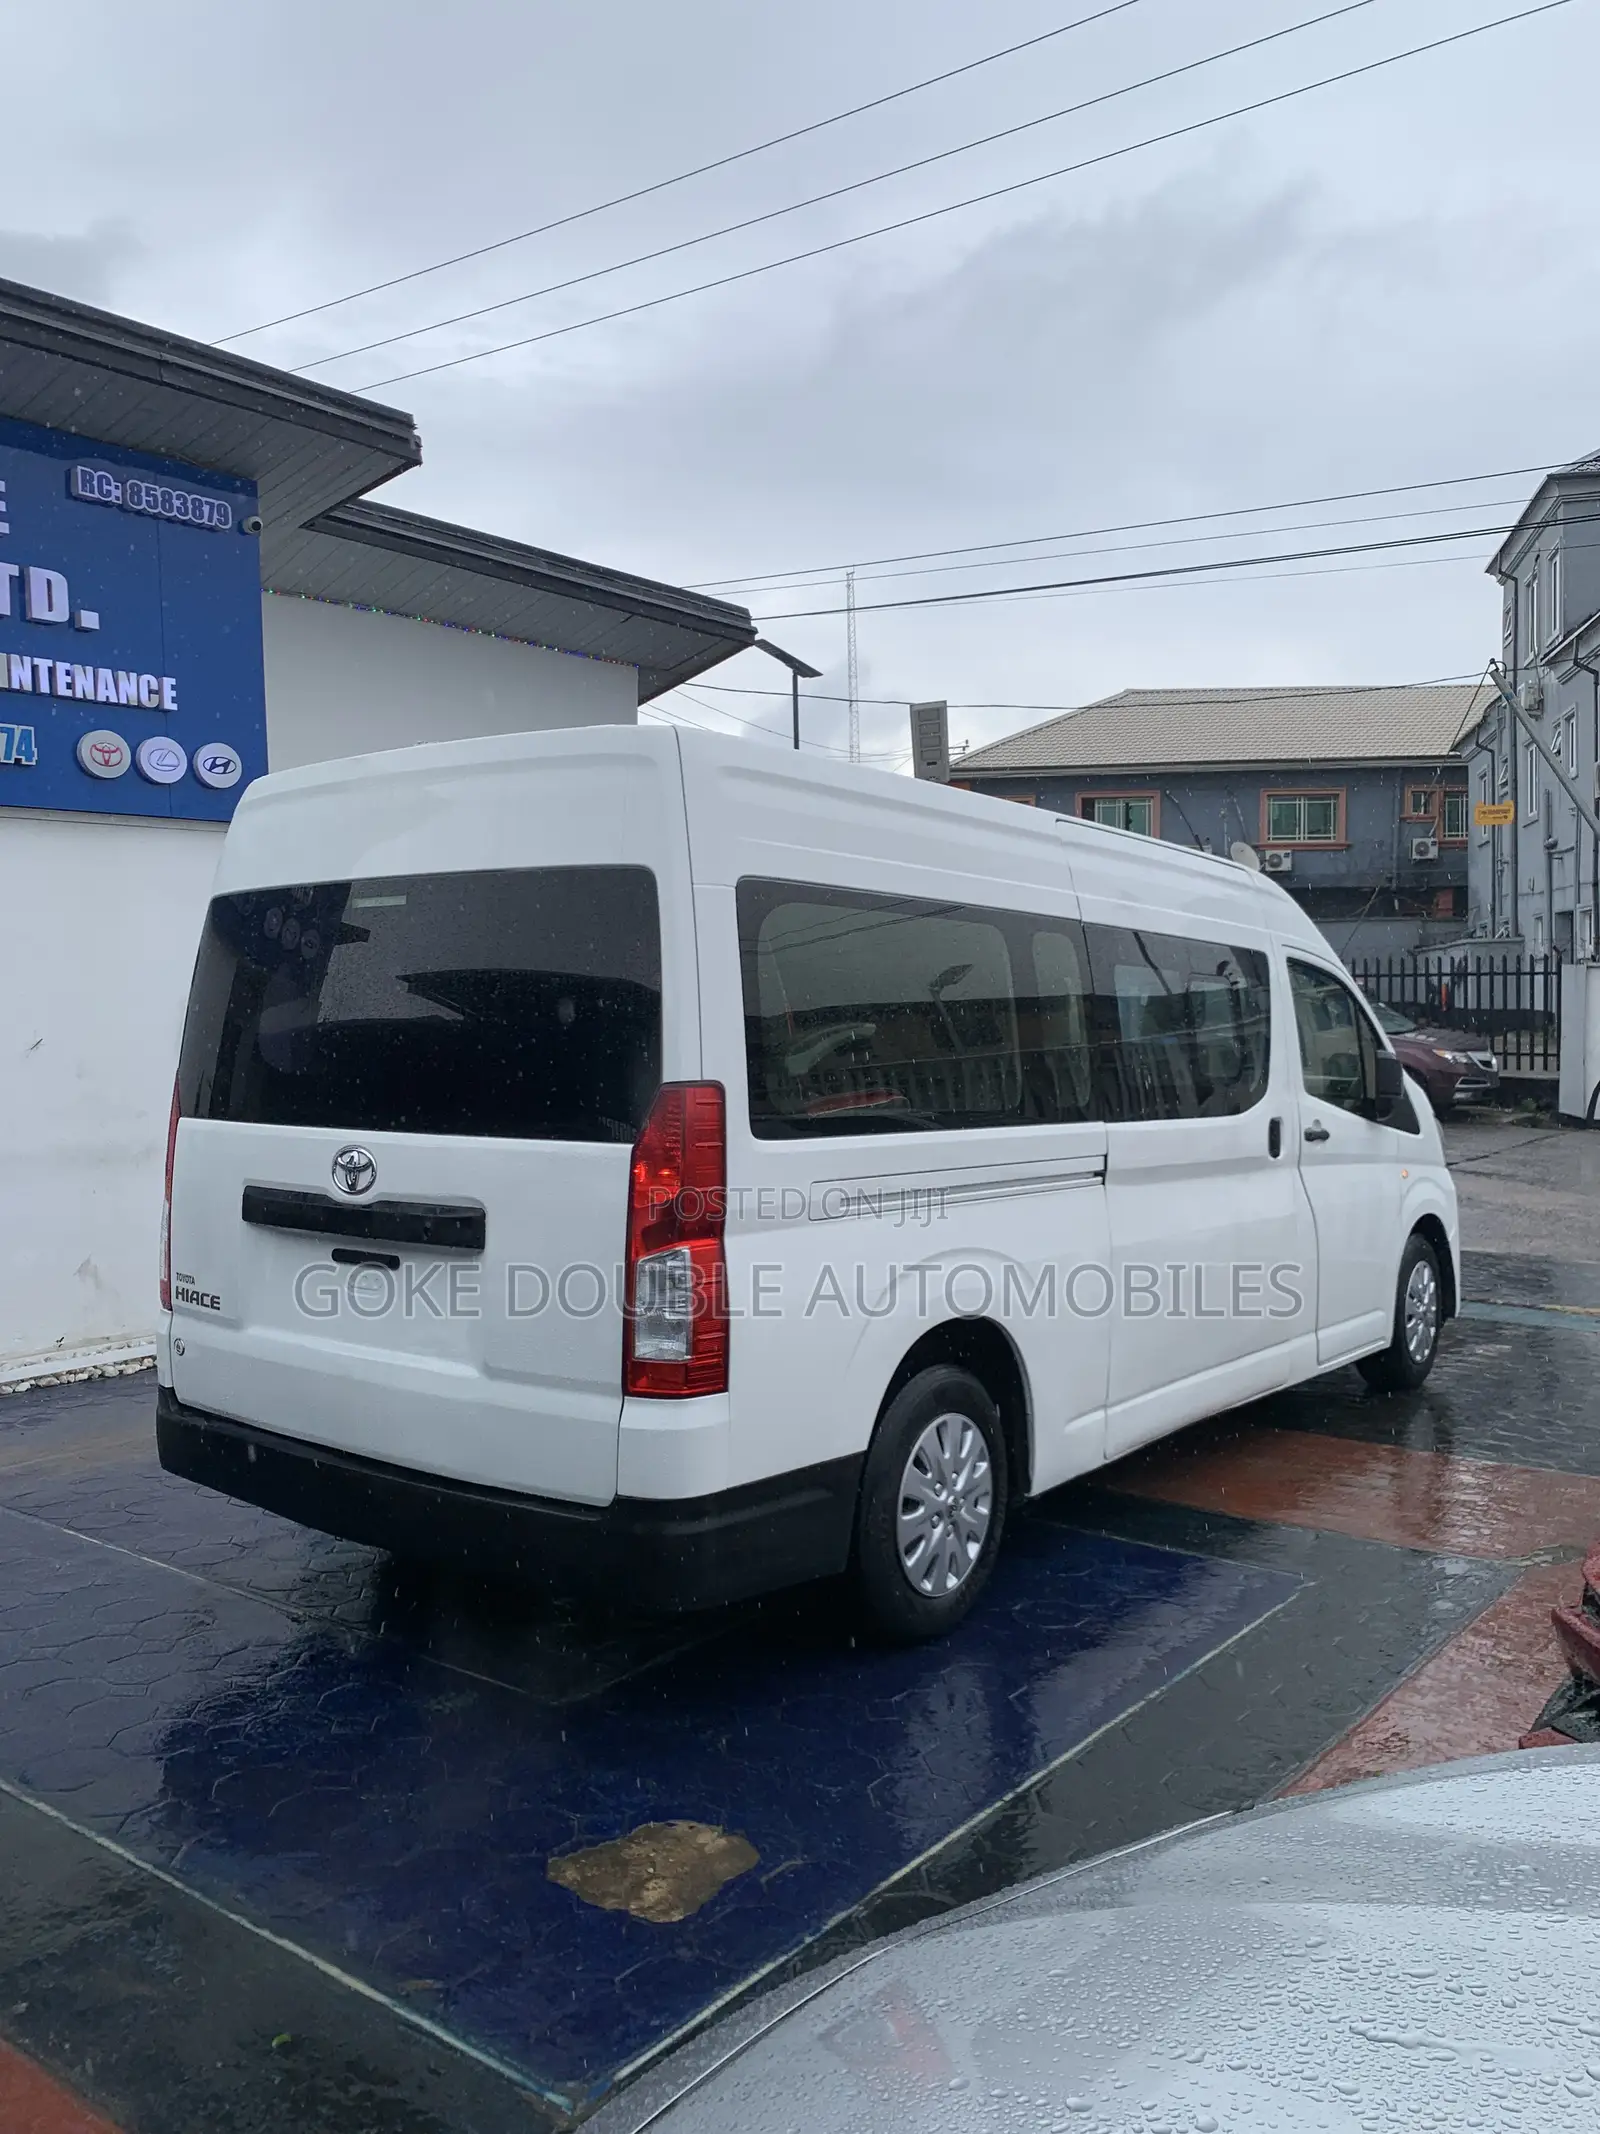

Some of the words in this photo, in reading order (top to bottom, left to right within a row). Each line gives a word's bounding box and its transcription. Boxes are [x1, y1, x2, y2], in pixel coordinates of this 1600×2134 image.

[76, 465, 122, 504] RC:
[126, 479, 232, 530] 8583879
[176, 1272, 195, 1285] TOYOTA
[175, 1286, 221, 1311] HIACE
